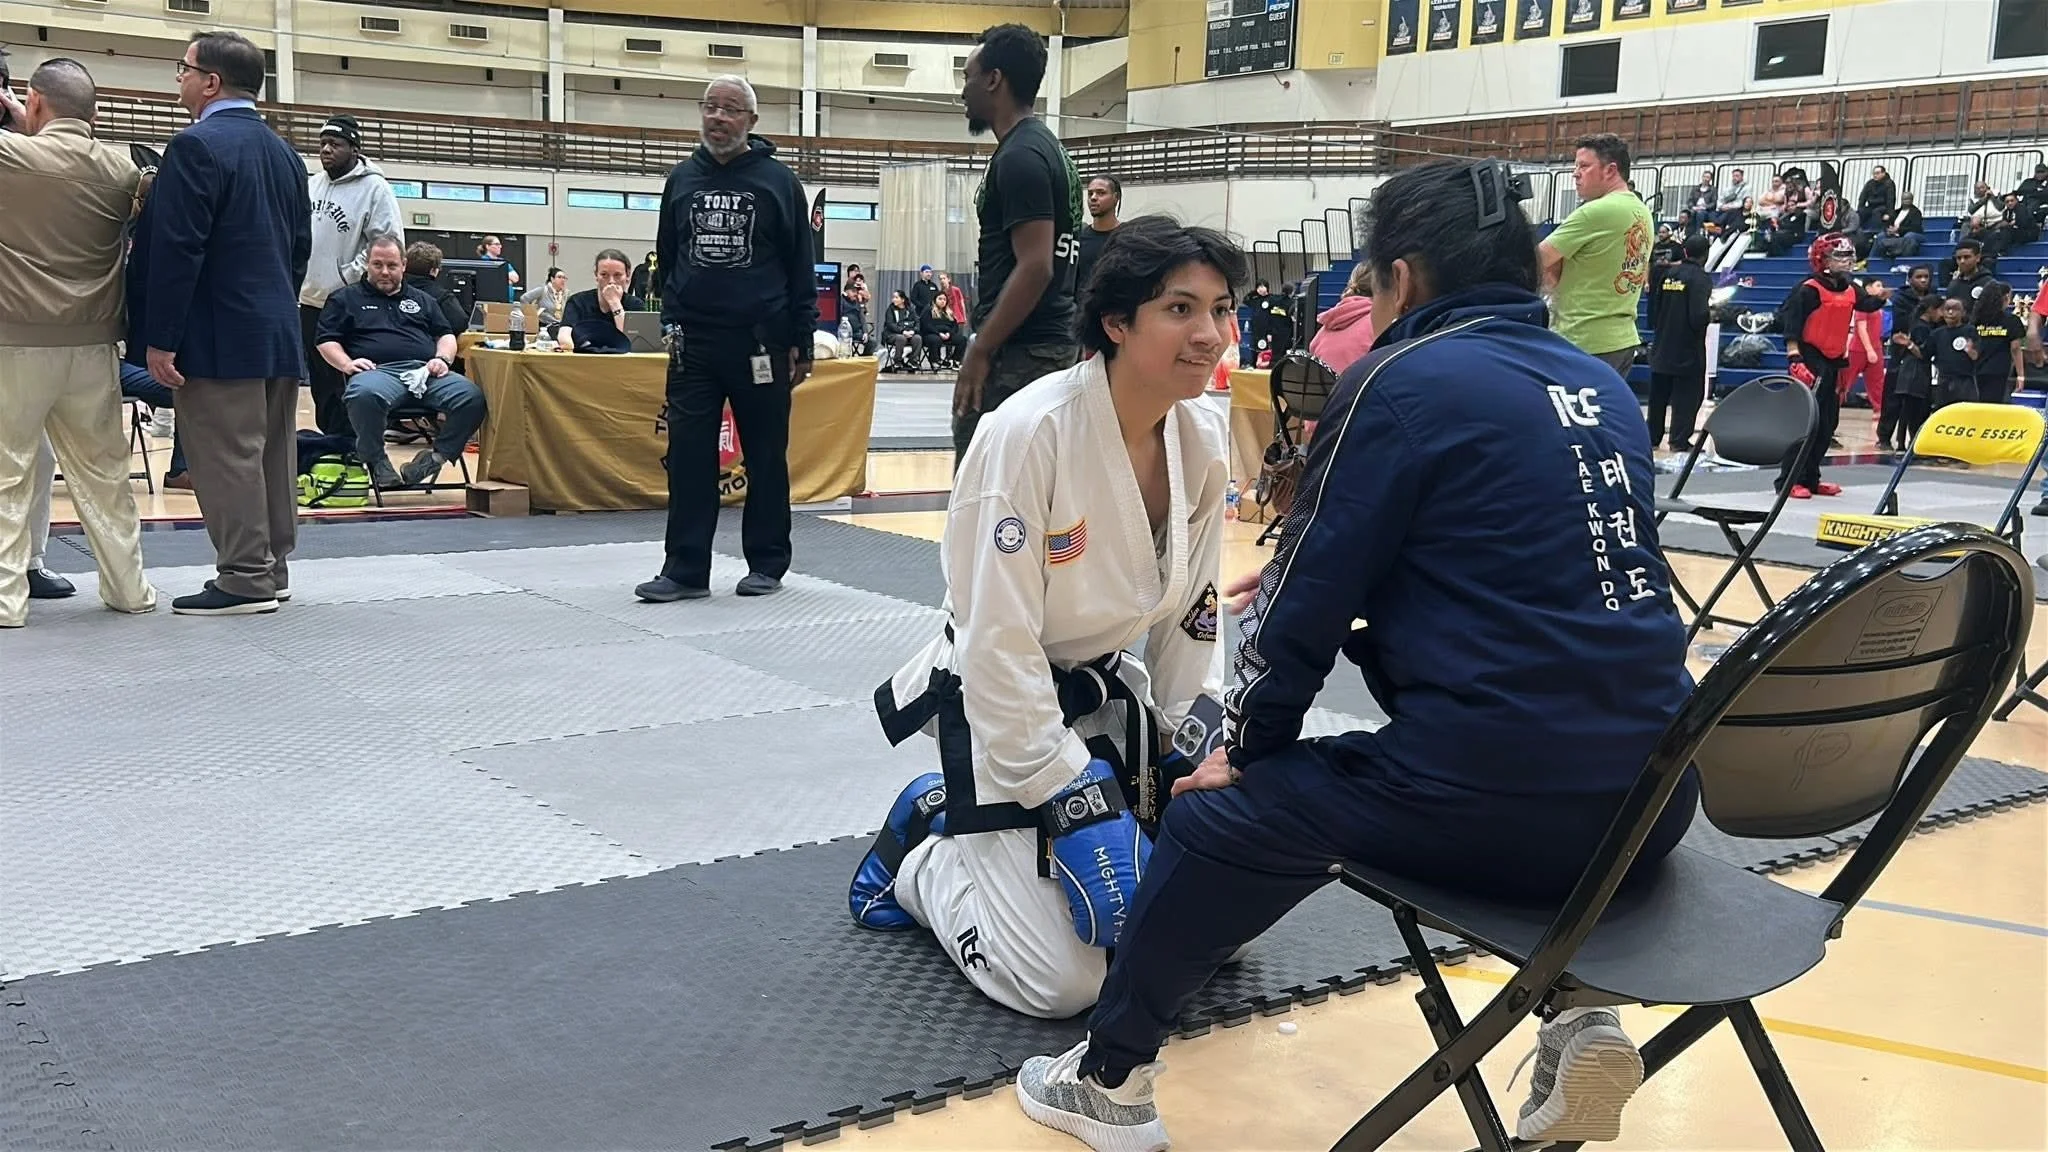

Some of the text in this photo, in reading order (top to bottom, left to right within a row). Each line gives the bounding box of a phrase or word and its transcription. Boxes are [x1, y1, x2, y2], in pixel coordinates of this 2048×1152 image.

[1269, 12, 1287, 21] GUEST
[1210, 20, 1231, 30] KNIGHTS
[704, 195, 741, 210] TONY
[1934, 424, 2028, 441] CCBC ESSEX
